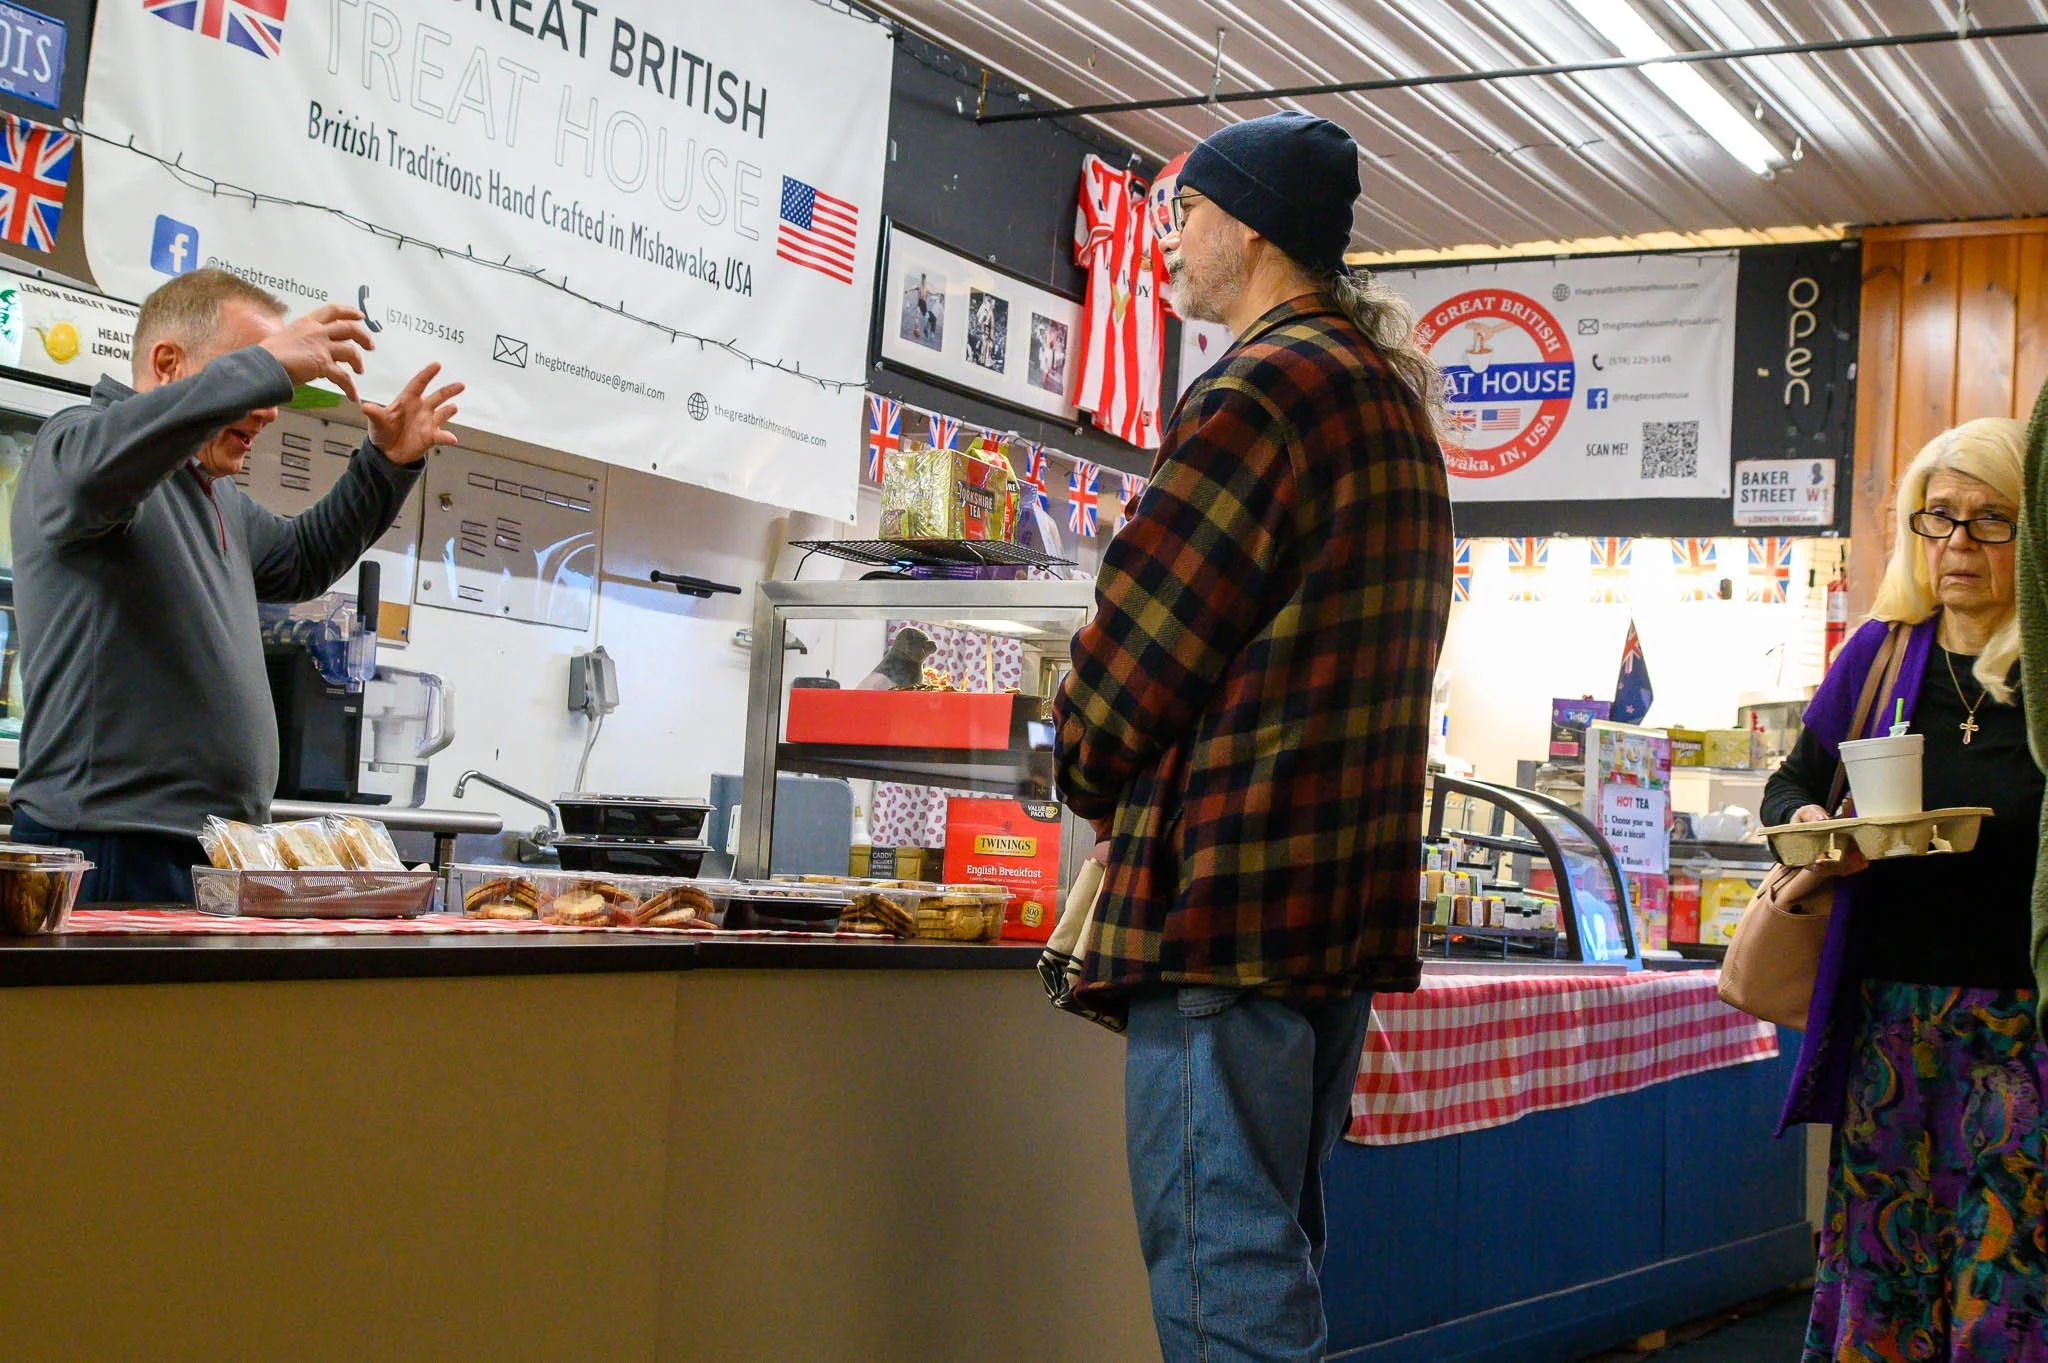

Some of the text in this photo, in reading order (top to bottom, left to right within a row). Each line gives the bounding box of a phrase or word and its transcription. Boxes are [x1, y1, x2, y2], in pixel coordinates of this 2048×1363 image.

[609, 17, 767, 139] BRITISH
[327, 0, 762, 241] TREAT HOUSE
[308, 100, 752, 297] British Traditions Hand Crafted in Mishawaka, USA
[206, 256, 328, 301] @thegbtreathouse
[19, 282, 60, 299] LEMON
[63, 293, 104, 310] BARLEY
[386, 307, 465, 344] (574) 229-5145
[1436, 297, 1496, 327] GREAT
[1500, 298, 1561, 353] BRITISH
[92, 343, 130, 361] LEMON
[535, 352, 665, 401] thegbtreathouse@gmail.com
[1482, 369, 1571, 394] HOUSE
[714, 404, 827, 448] thegreatbritishtreathouse.com
[1446, 454, 1495, 472] waka,
[1525, 414, 1556, 447] USA
[1586, 443, 1610, 456] SCAN
[1742, 471, 1788, 485] BAKER
[958, 481, 993, 509] YORKSHIRE
[1741, 488, 1796, 503] STREET
[969, 504, 981, 519] TEA
[1616, 796, 1649, 809] HOT TEA
[1611, 815, 1630, 825] Choose
[1611, 828, 1622, 837] Add
[981, 837, 1031, 850] TWININGS
[967, 865, 1042, 878] English Breakfast
